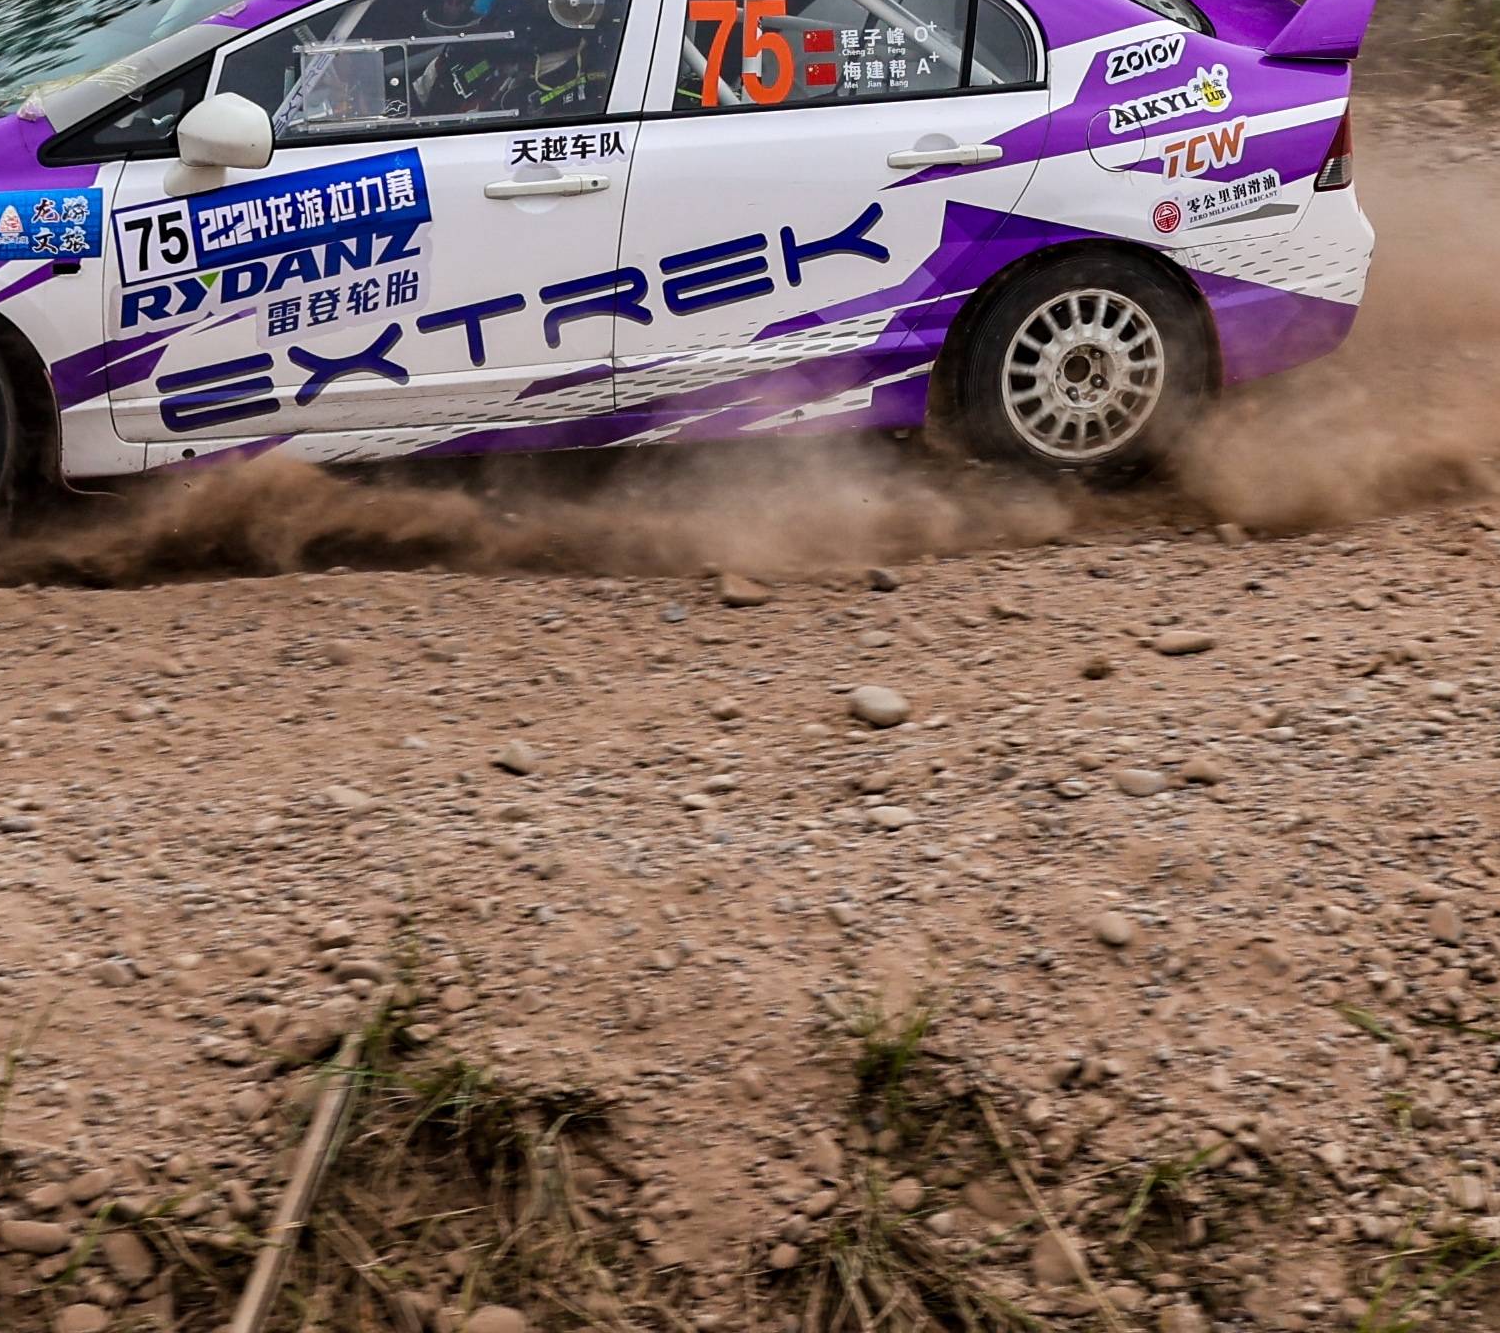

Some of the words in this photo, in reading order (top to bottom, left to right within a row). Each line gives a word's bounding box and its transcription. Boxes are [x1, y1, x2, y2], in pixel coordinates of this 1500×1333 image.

[840, 27, 905, 48] 程子峰
[841, 48, 866, 57] Cheng
[866, 47, 874, 55] Zi
[887, 46, 906, 55] Feng
[843, 59, 906, 81] 梅建帮
[844, 81, 859, 89] Mei
[867, 80, 882, 88] Jian
[889, 79, 909, 88] Bang
[510, 131, 625, 165] 天越车队
[1164, 121, 1245, 179] TCW
[197, 168, 417, 252] 2024龙游拉力赛
[1187, 174, 1277, 213] 零公里润滑油
[1189, 213, 1208, 224] ZERO
[1209, 202, 1239, 218] MILEAGE
[1240, 190, 1278, 208] LUBRICANT
[123, 210, 190, 272] 75
[120, 232, 422, 329] RYDANZ
[156, 202, 891, 432] EXTREK
[267, 269, 420, 337] 雷登轮胎
